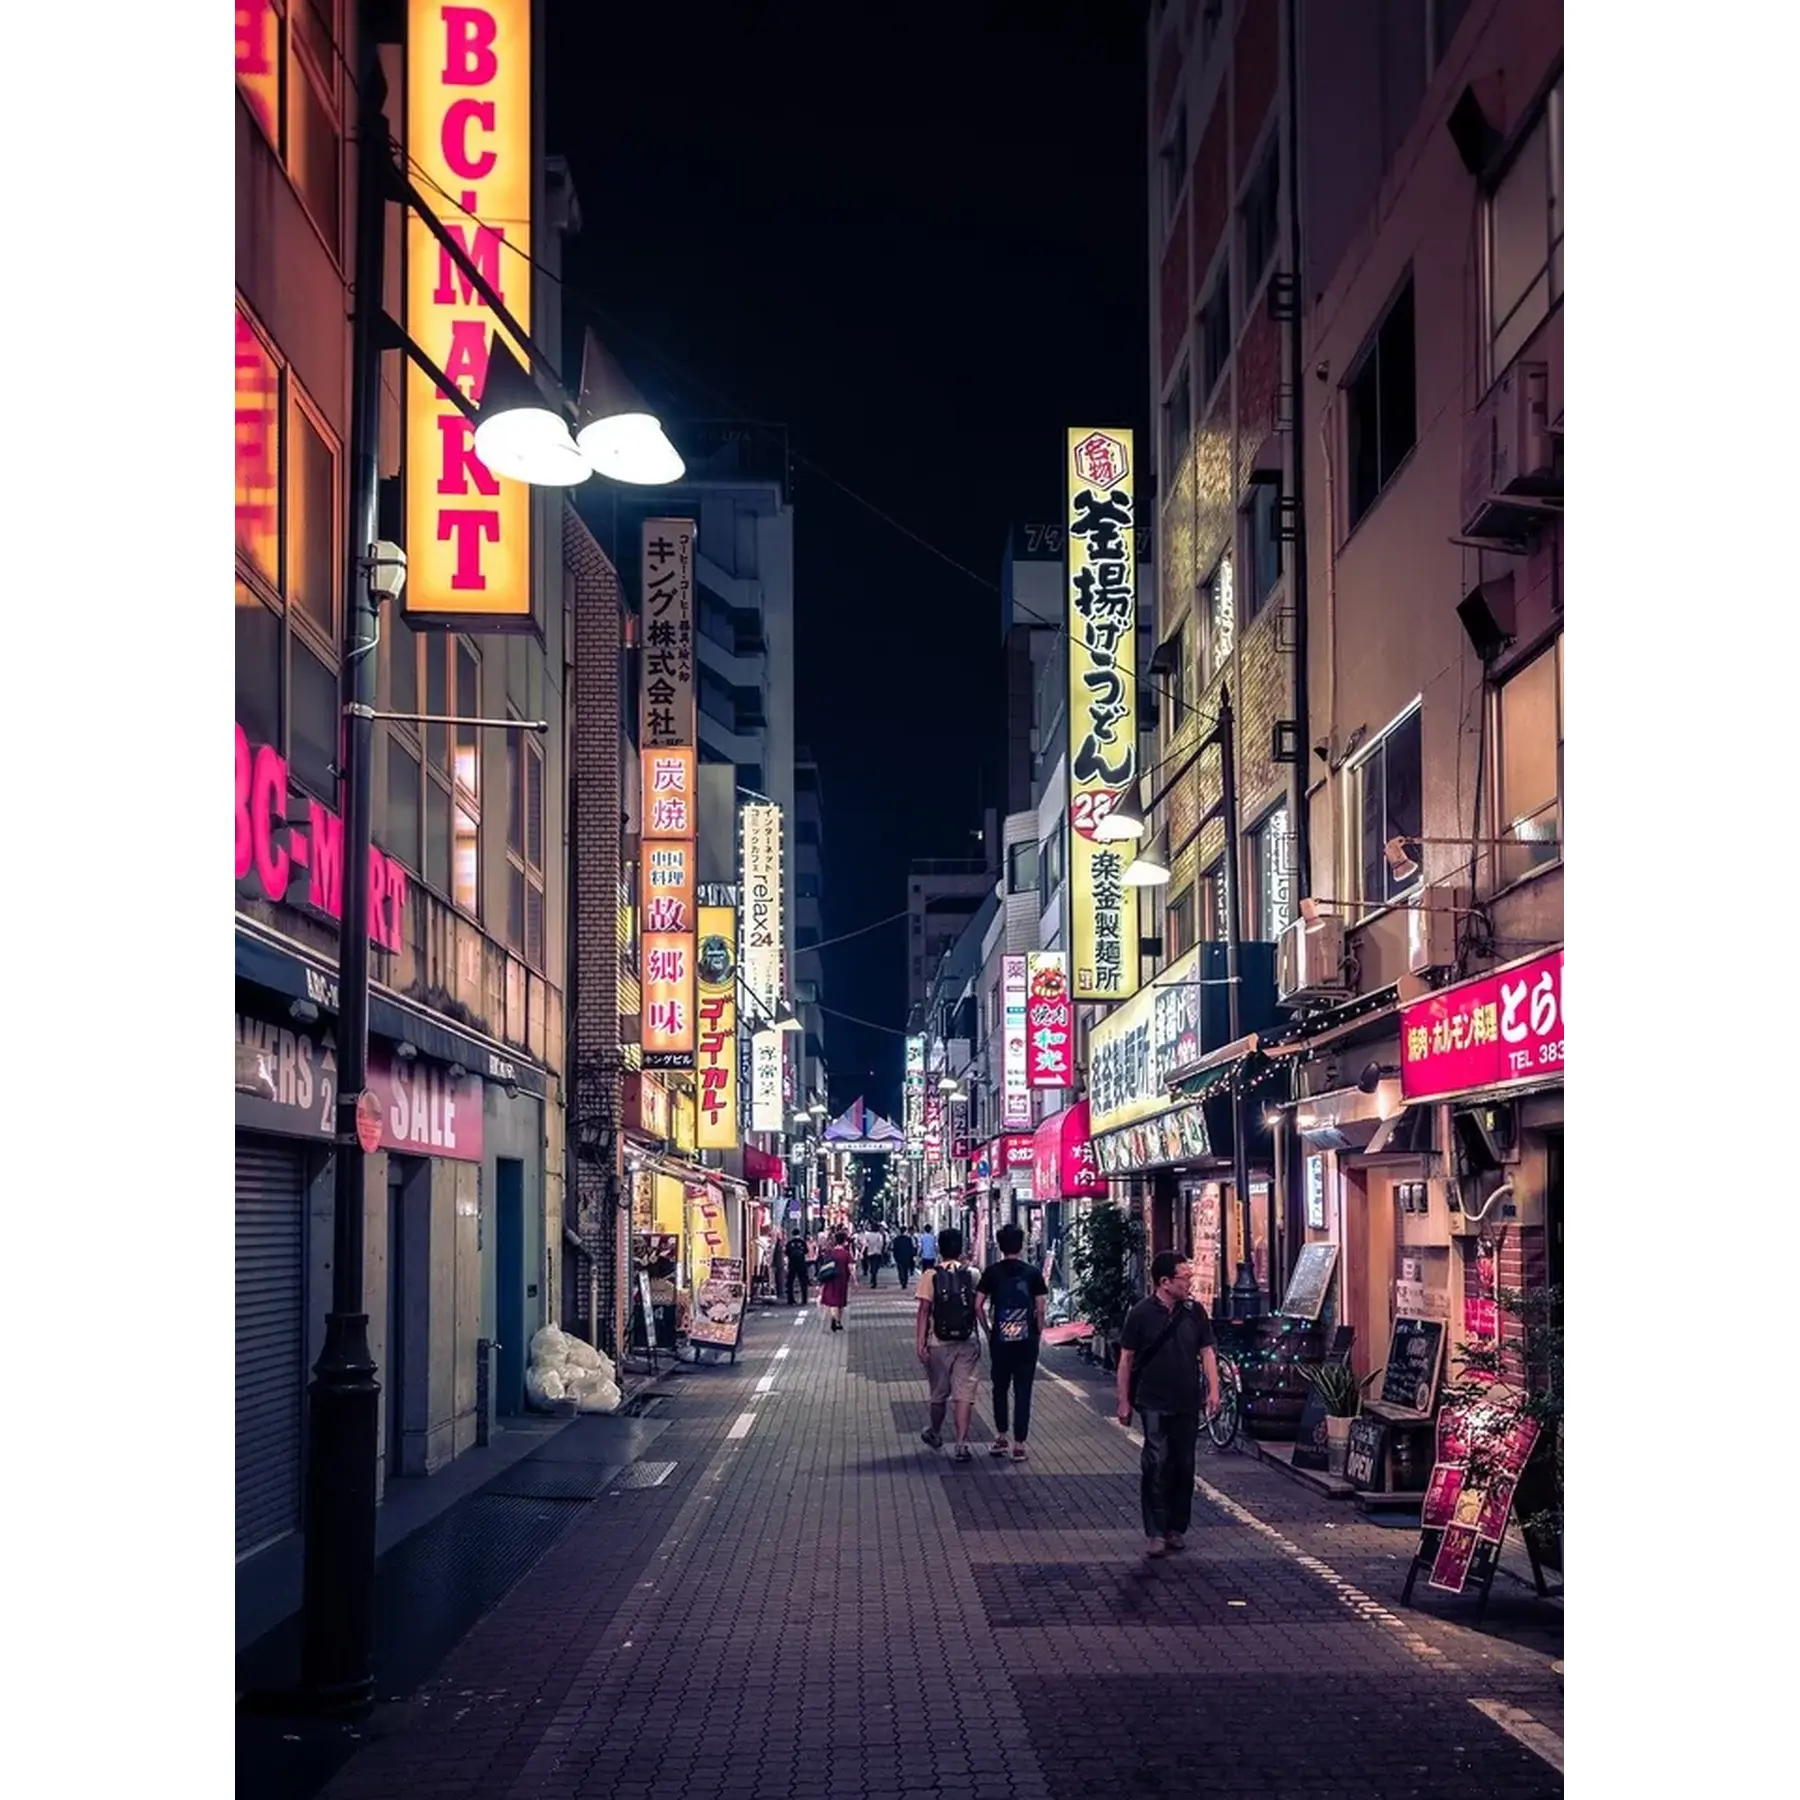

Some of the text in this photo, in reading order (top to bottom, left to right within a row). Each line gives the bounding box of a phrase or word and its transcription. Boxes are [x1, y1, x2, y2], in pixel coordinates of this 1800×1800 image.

[647, 537, 677, 736] キング株式会社
[1071, 489, 1135, 787] 釜揚げうどん
[654, 757, 686, 830] 炭焼
[651, 851, 684, 867] 中国
[651, 870, 684, 887] 料理
[750, 932, 774, 947] 24
[752, 874, 773, 931] relax
[1092, 851, 1123, 992] 楽釜製麺所
[648, 896, 684, 1034] 故郷味
[1501, 964, 1564, 1043] とら
[645, 1054, 692, 1066] キングビル
[699, 996, 734, 1126] ゴーゴーカレー
[1508, 1049, 1534, 1070] TEL
[389, 1058, 456, 1149] SALE
